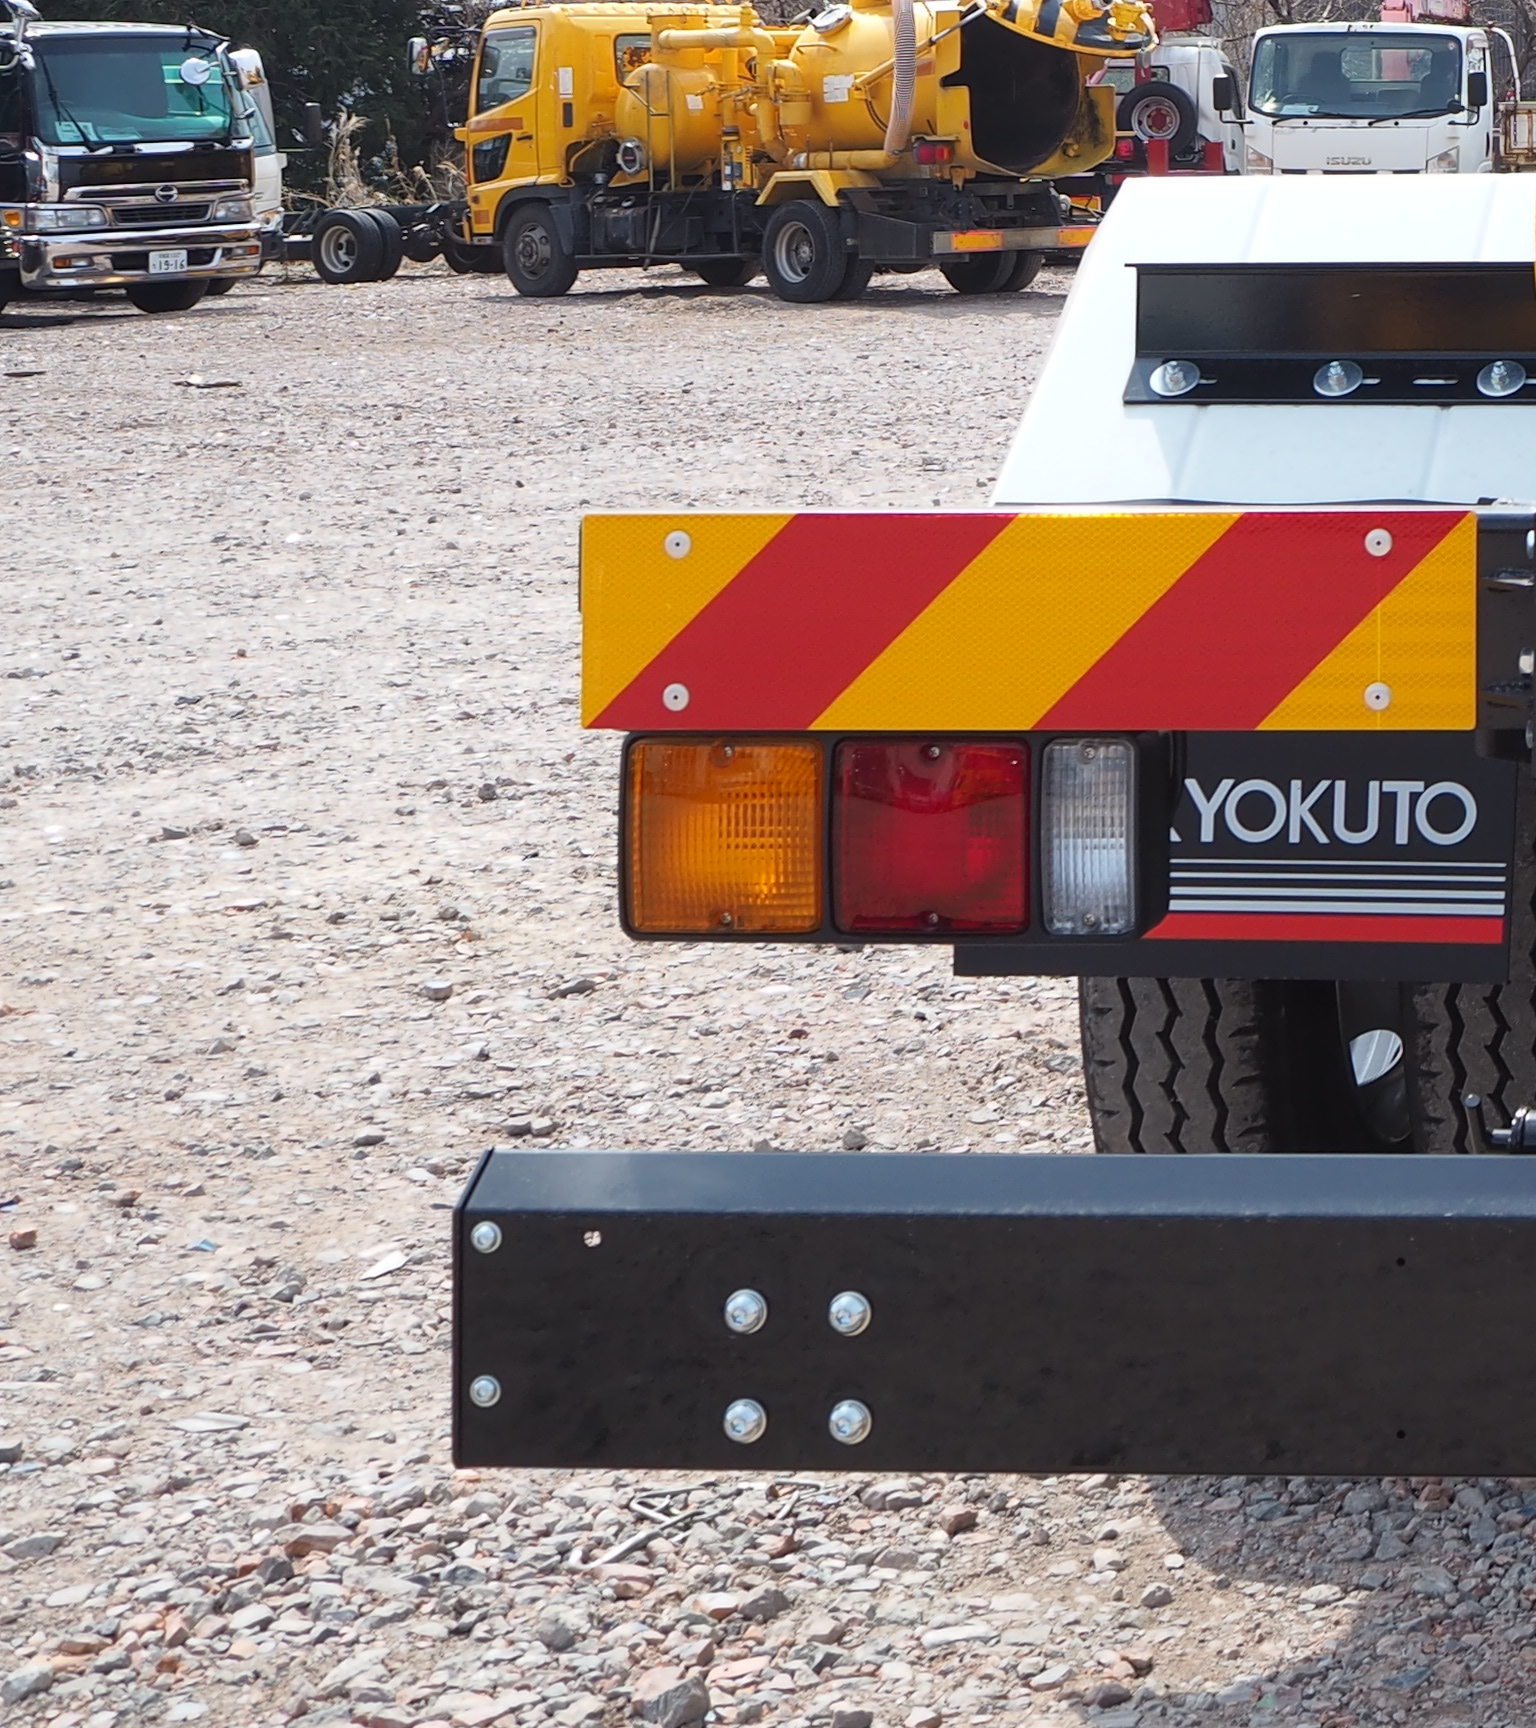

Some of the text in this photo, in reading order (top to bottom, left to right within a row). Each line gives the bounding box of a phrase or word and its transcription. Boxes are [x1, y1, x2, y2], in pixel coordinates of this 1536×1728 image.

[1326, 156, 1372, 166] ISUZU
[159, 259, 186, 271] 19-16
[1170, 778, 1478, 846] YOKUTO
